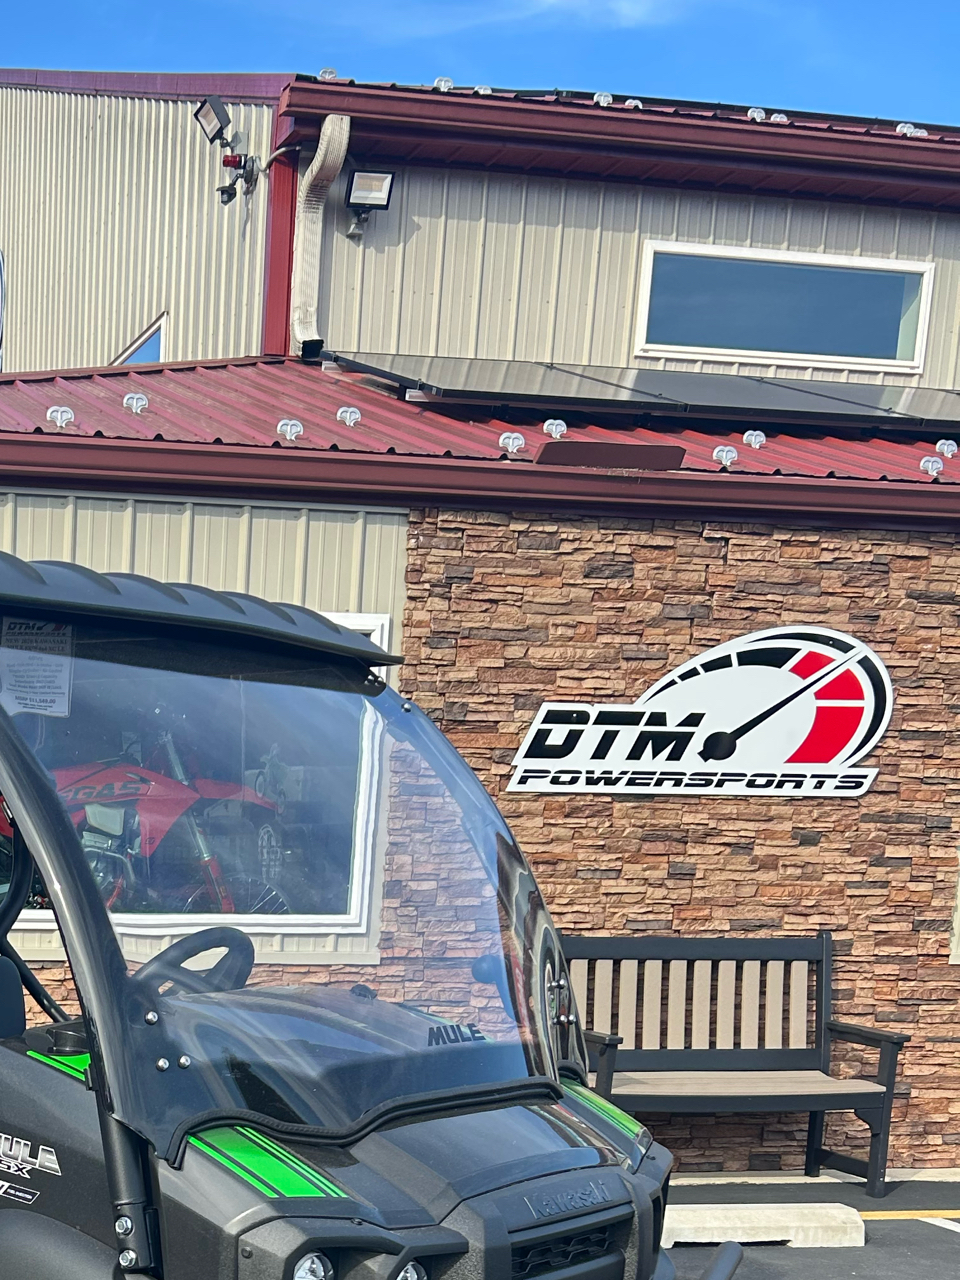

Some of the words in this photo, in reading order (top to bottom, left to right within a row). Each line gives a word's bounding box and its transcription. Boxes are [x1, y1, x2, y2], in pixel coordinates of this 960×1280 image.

[522, 709, 706, 763] DTM
[516, 768, 870, 791] POWERSPORTS
[428, 1022, 487, 1047] MULE
[523, 1179, 613, 1220] Kawasaki
